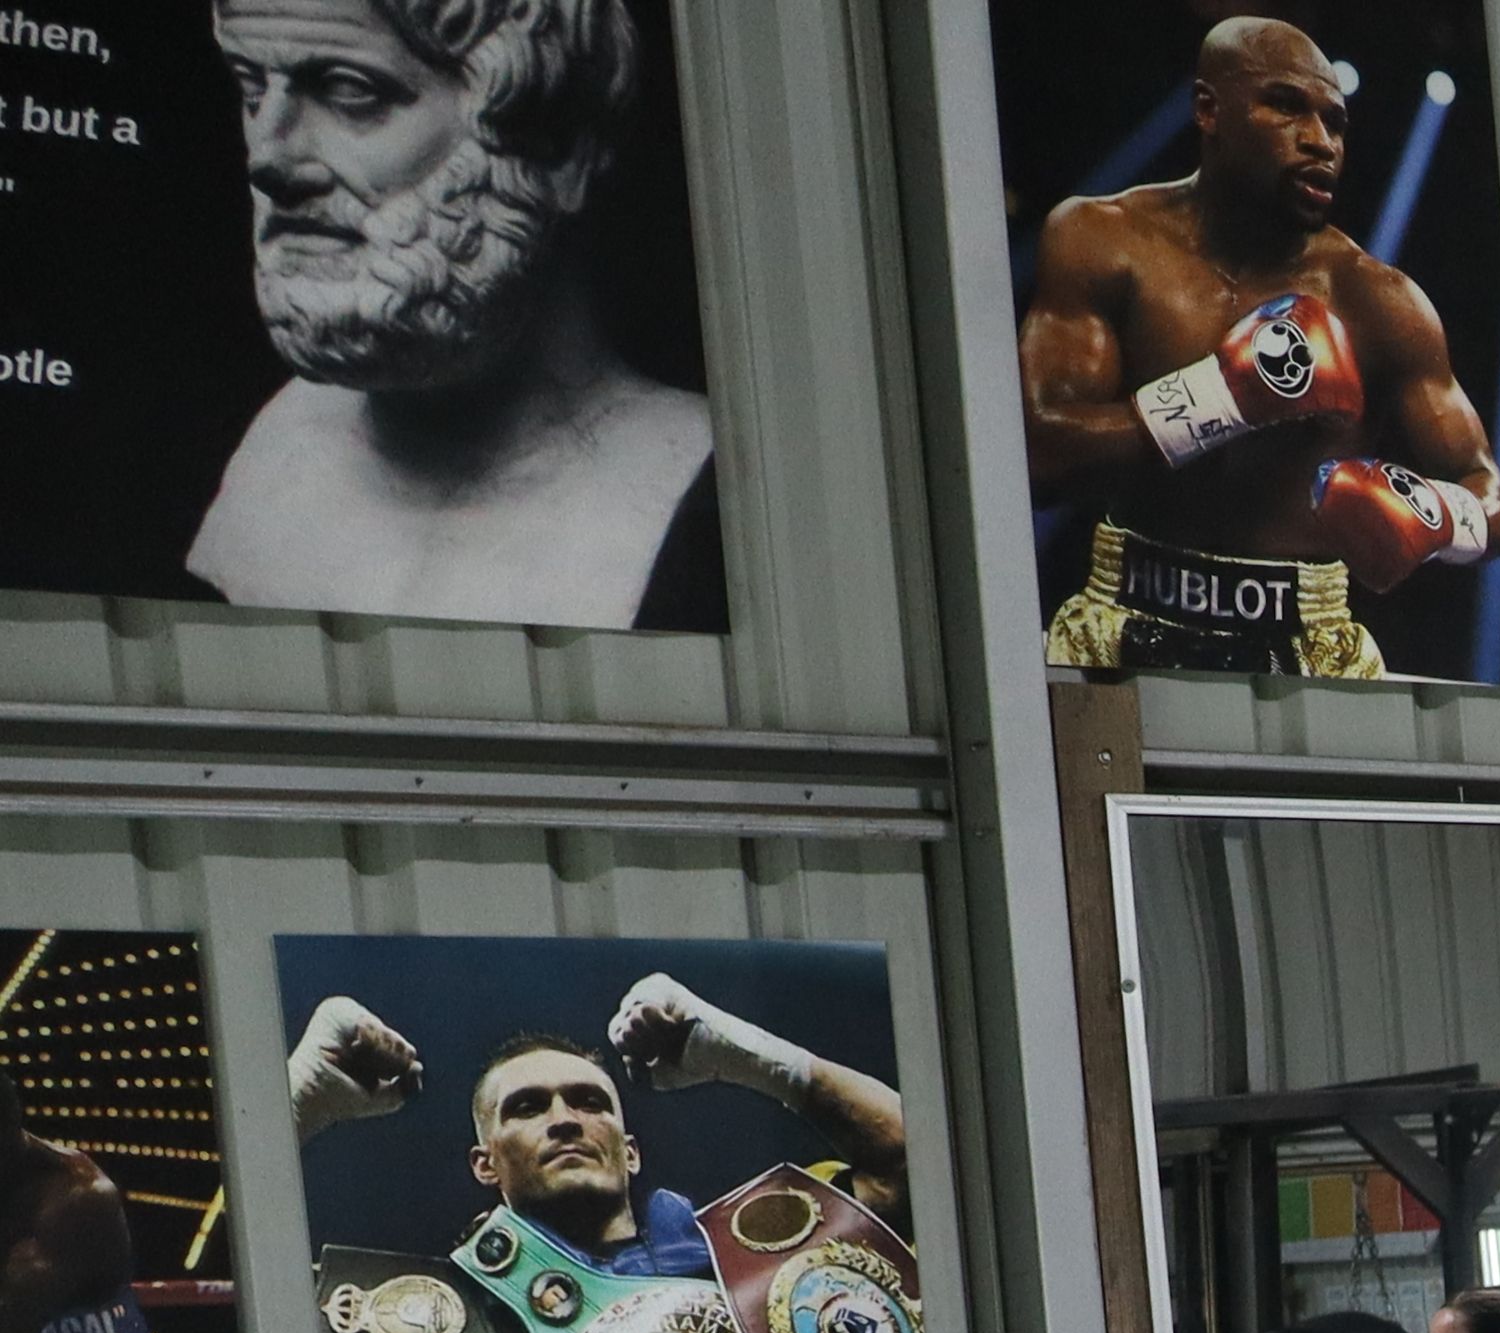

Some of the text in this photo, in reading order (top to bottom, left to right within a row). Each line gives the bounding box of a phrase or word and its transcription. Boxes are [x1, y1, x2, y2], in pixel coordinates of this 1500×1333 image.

[0, 10, 110, 64] then,
[22, 96, 99, 140] but
[112, 116, 140, 145] a
[1126, 559, 1291, 622] HUBLOT
